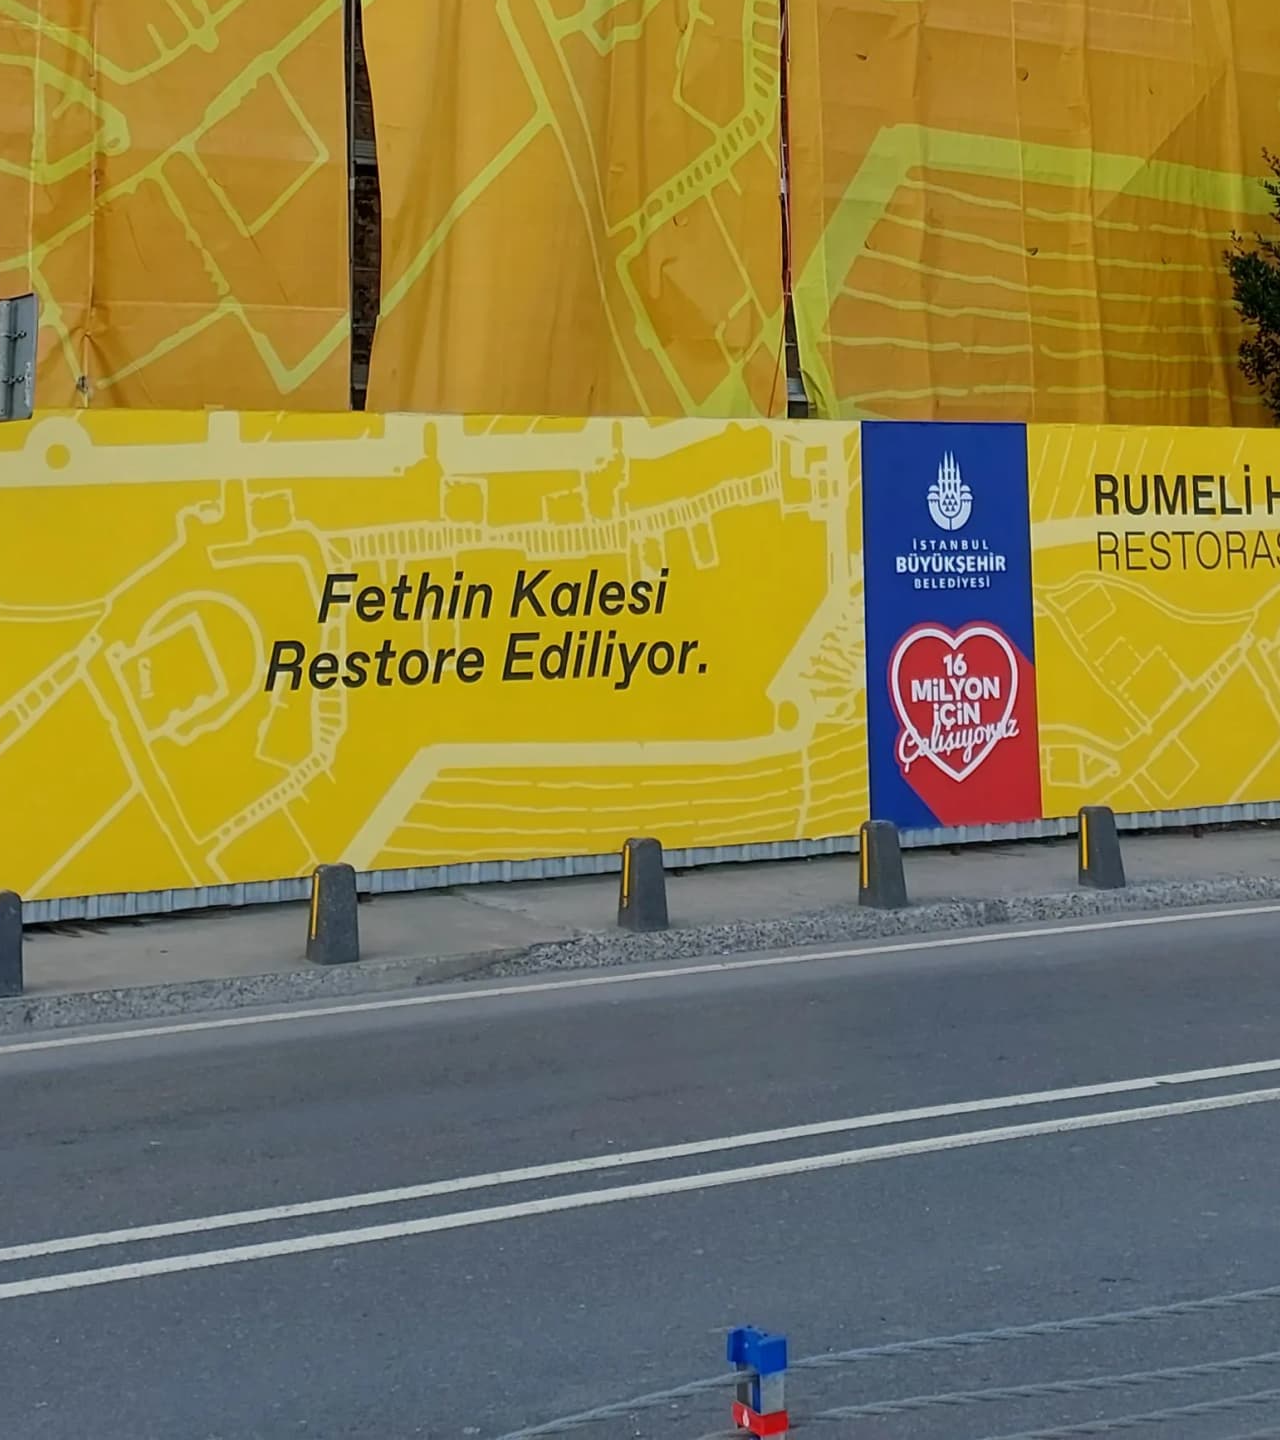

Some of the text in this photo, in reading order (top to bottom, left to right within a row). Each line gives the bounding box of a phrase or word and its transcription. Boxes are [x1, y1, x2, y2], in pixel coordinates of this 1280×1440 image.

[1094, 464, 1253, 515] RUMELİ
[912, 538, 990, 551] İSTANBUL
[895, 552, 1006, 574] BÜYÜKŞEHİR
[913, 575, 991, 590] BELEDİYESİ
[317, 567, 669, 623] Fethin Kalesi
[264, 630, 708, 692] Restore Ediliyor.
[942, 653, 968, 677] 16
